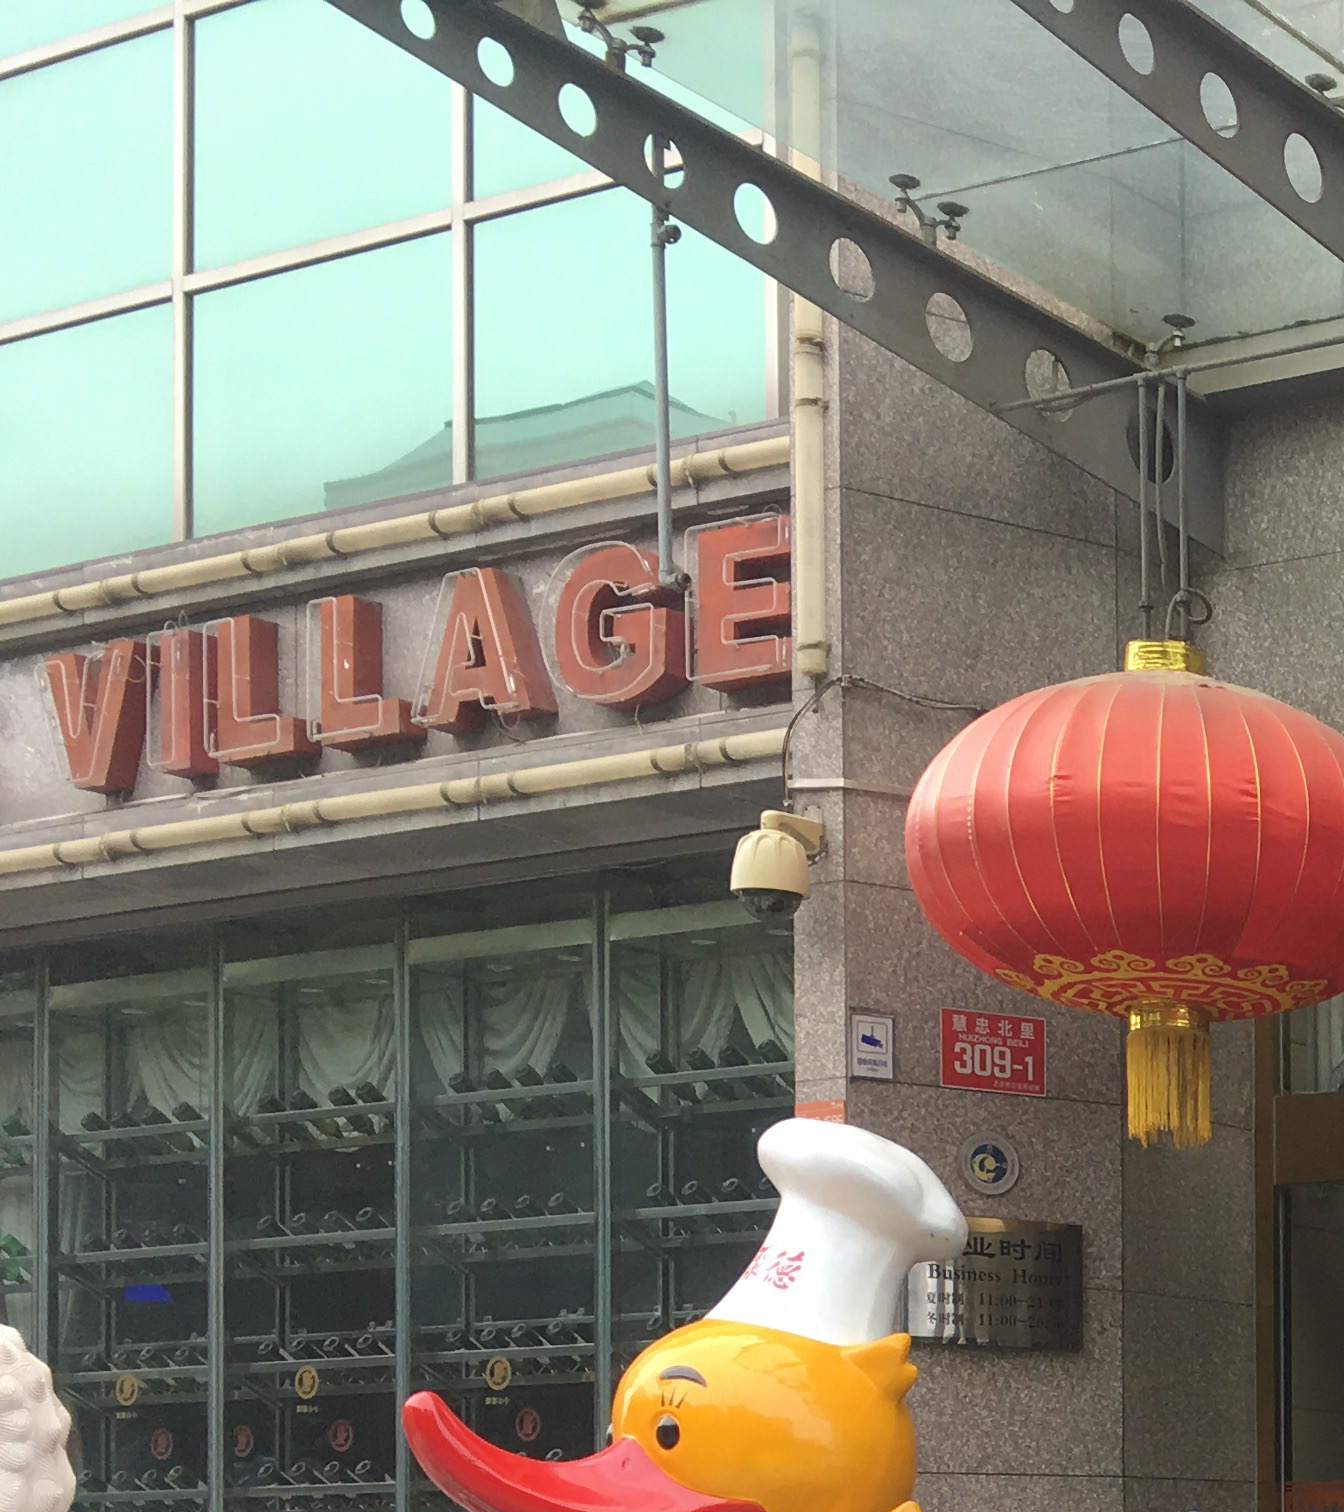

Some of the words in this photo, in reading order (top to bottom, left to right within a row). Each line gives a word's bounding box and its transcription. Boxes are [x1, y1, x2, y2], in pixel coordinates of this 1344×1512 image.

[38, 512, 794, 794] VILLAGE
[952, 1014, 1035, 1039] 慧忠北里
[953, 1041, 1034, 1081] 309-1
[928, 1263, 1001, 1282] Business
